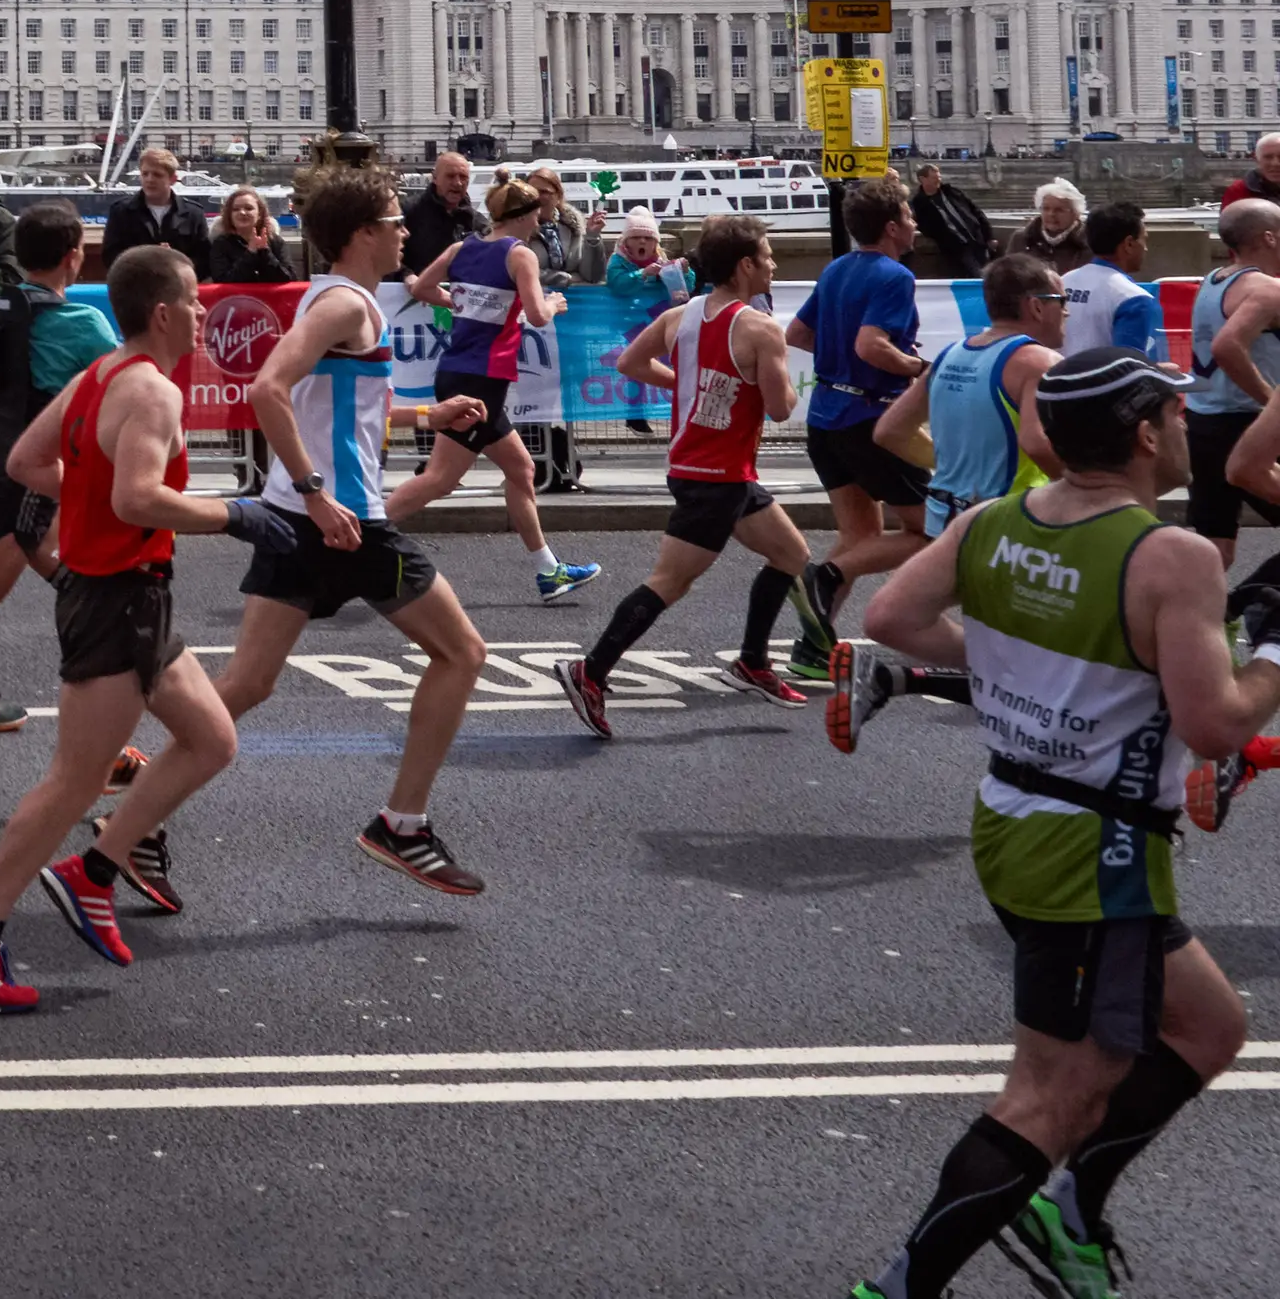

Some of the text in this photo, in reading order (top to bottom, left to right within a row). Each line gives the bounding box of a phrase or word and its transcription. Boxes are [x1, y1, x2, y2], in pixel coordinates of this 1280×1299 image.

[833, 59, 870, 67] WARNING
[825, 153, 856, 172] NO
[212, 307, 274, 363] Virgin
[988, 535, 1081, 594] McPin
[1060, 707, 1101, 734] for
[1016, 722, 1085, 761] health
